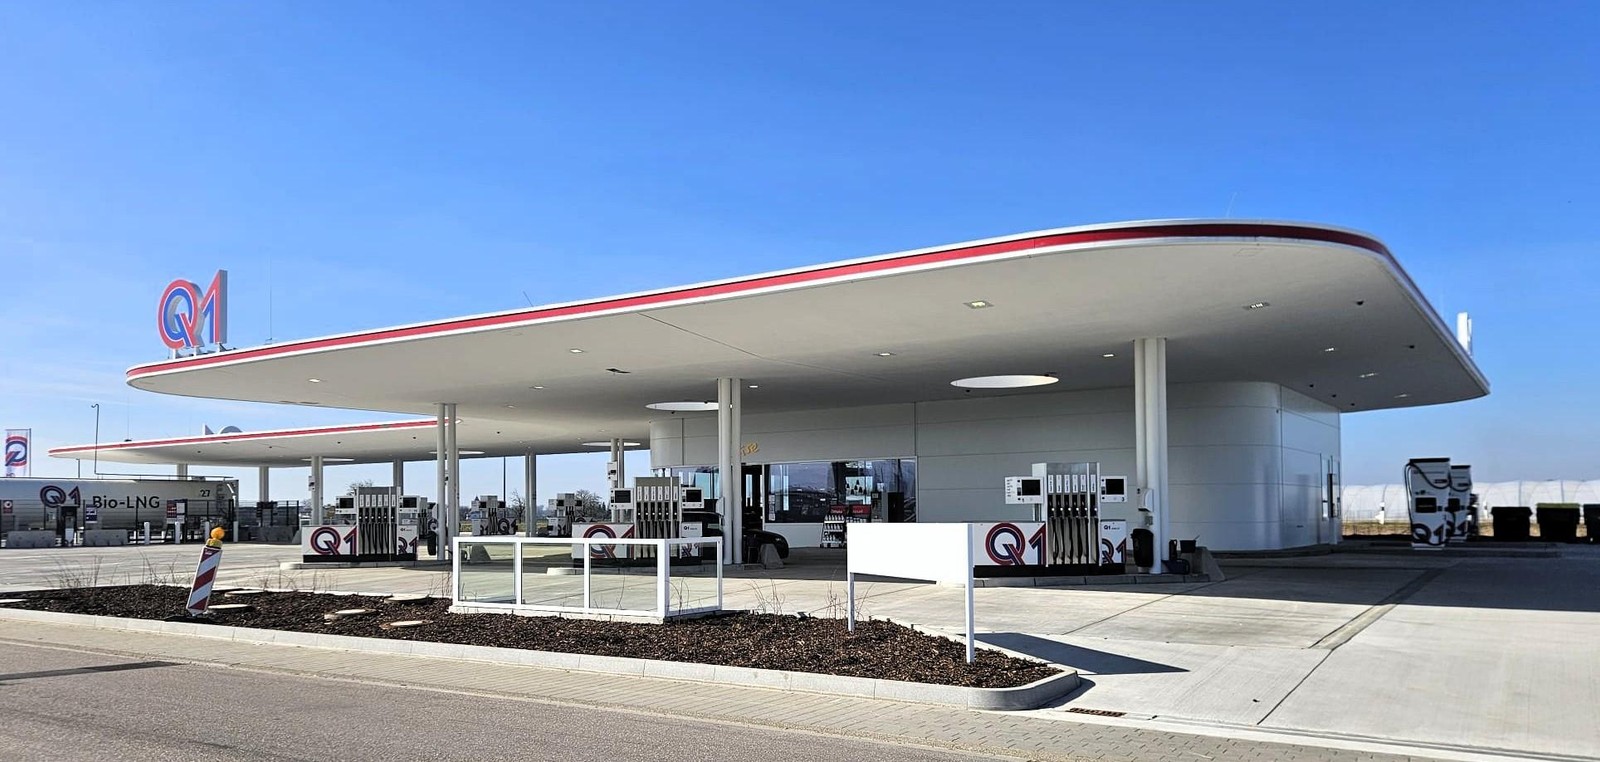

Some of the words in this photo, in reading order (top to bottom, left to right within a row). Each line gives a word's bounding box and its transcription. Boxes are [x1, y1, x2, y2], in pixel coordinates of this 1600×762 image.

[158, 269, 227, 350] Q1
[39, 485, 81, 508] Q1
[92, 495, 160, 509] Bio-LNG
[310, 526, 358, 556] Q1
[583, 524, 635, 559] Q1
[985, 522, 1047, 566] Q1
[1411, 523, 1445, 545] Q1
[1102, 537, 1127, 565] Q1
